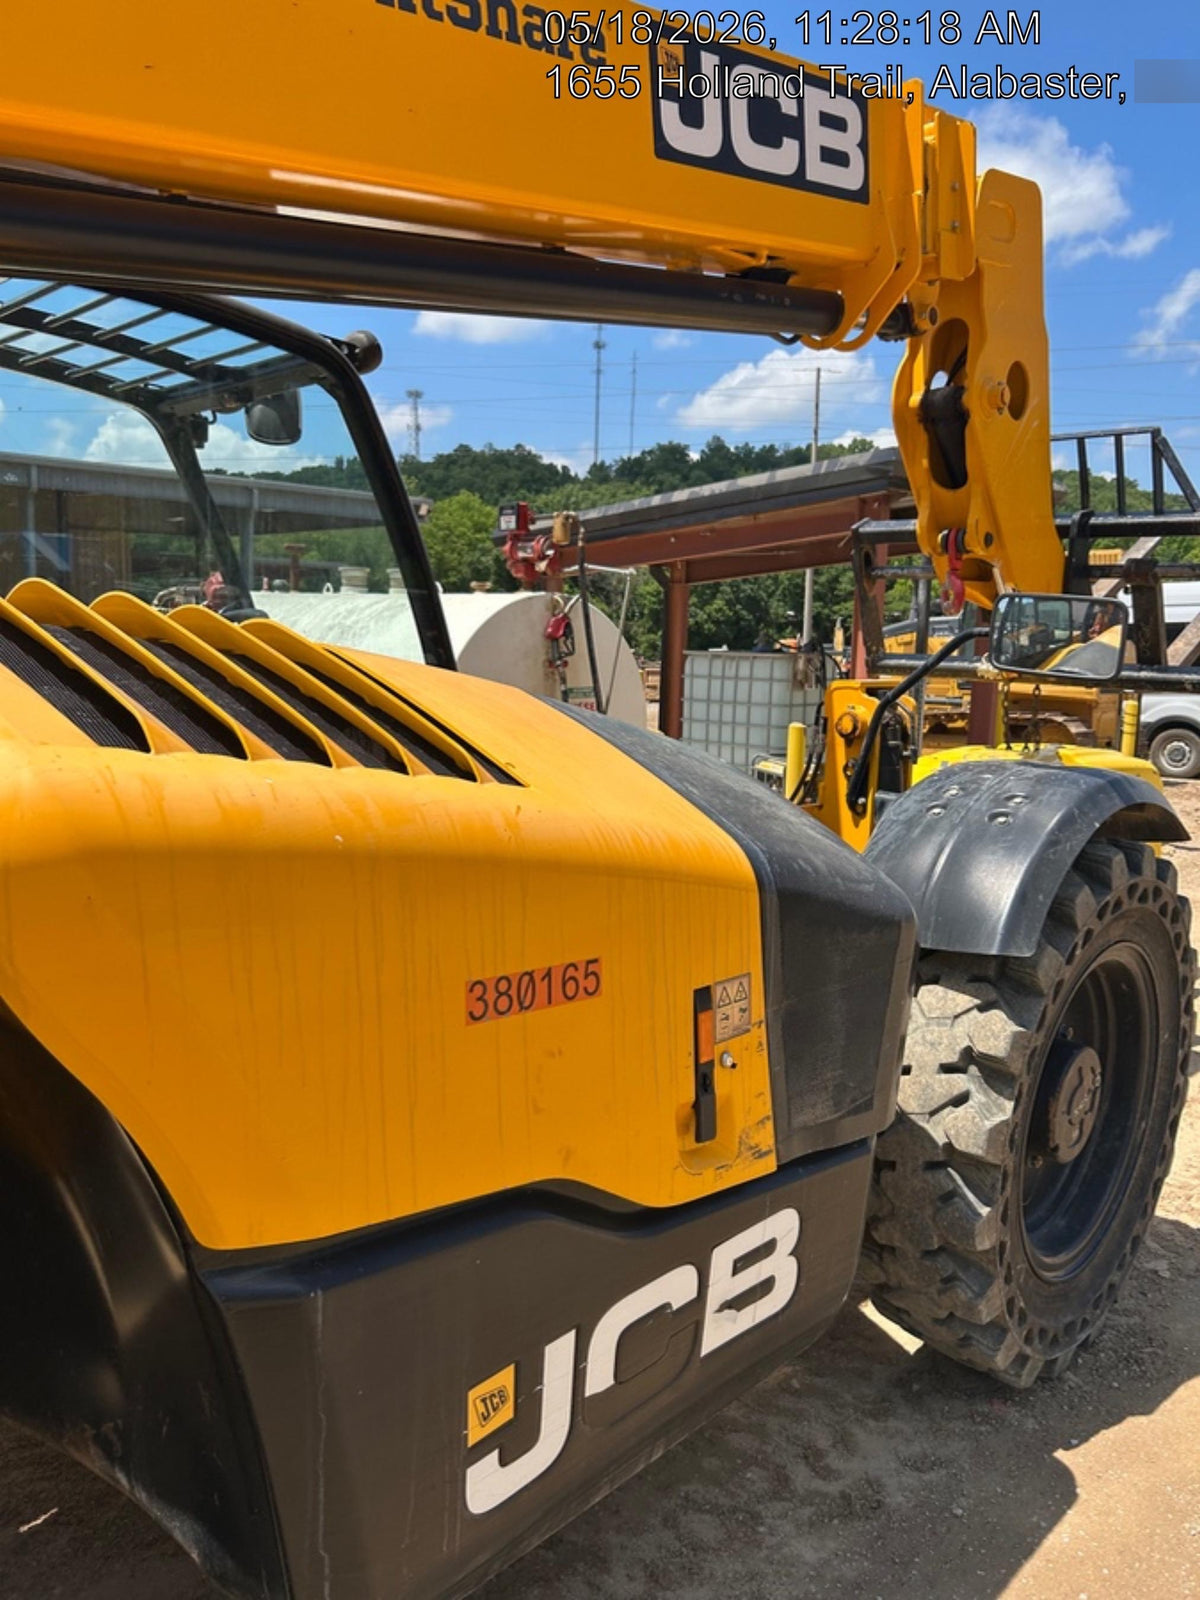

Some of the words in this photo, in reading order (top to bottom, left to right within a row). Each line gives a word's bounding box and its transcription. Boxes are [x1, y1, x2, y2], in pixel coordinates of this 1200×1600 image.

[660, 51, 866, 191] JCB
[468, 957, 600, 1022] 380165
[480, 1389, 508, 1422] JCB
